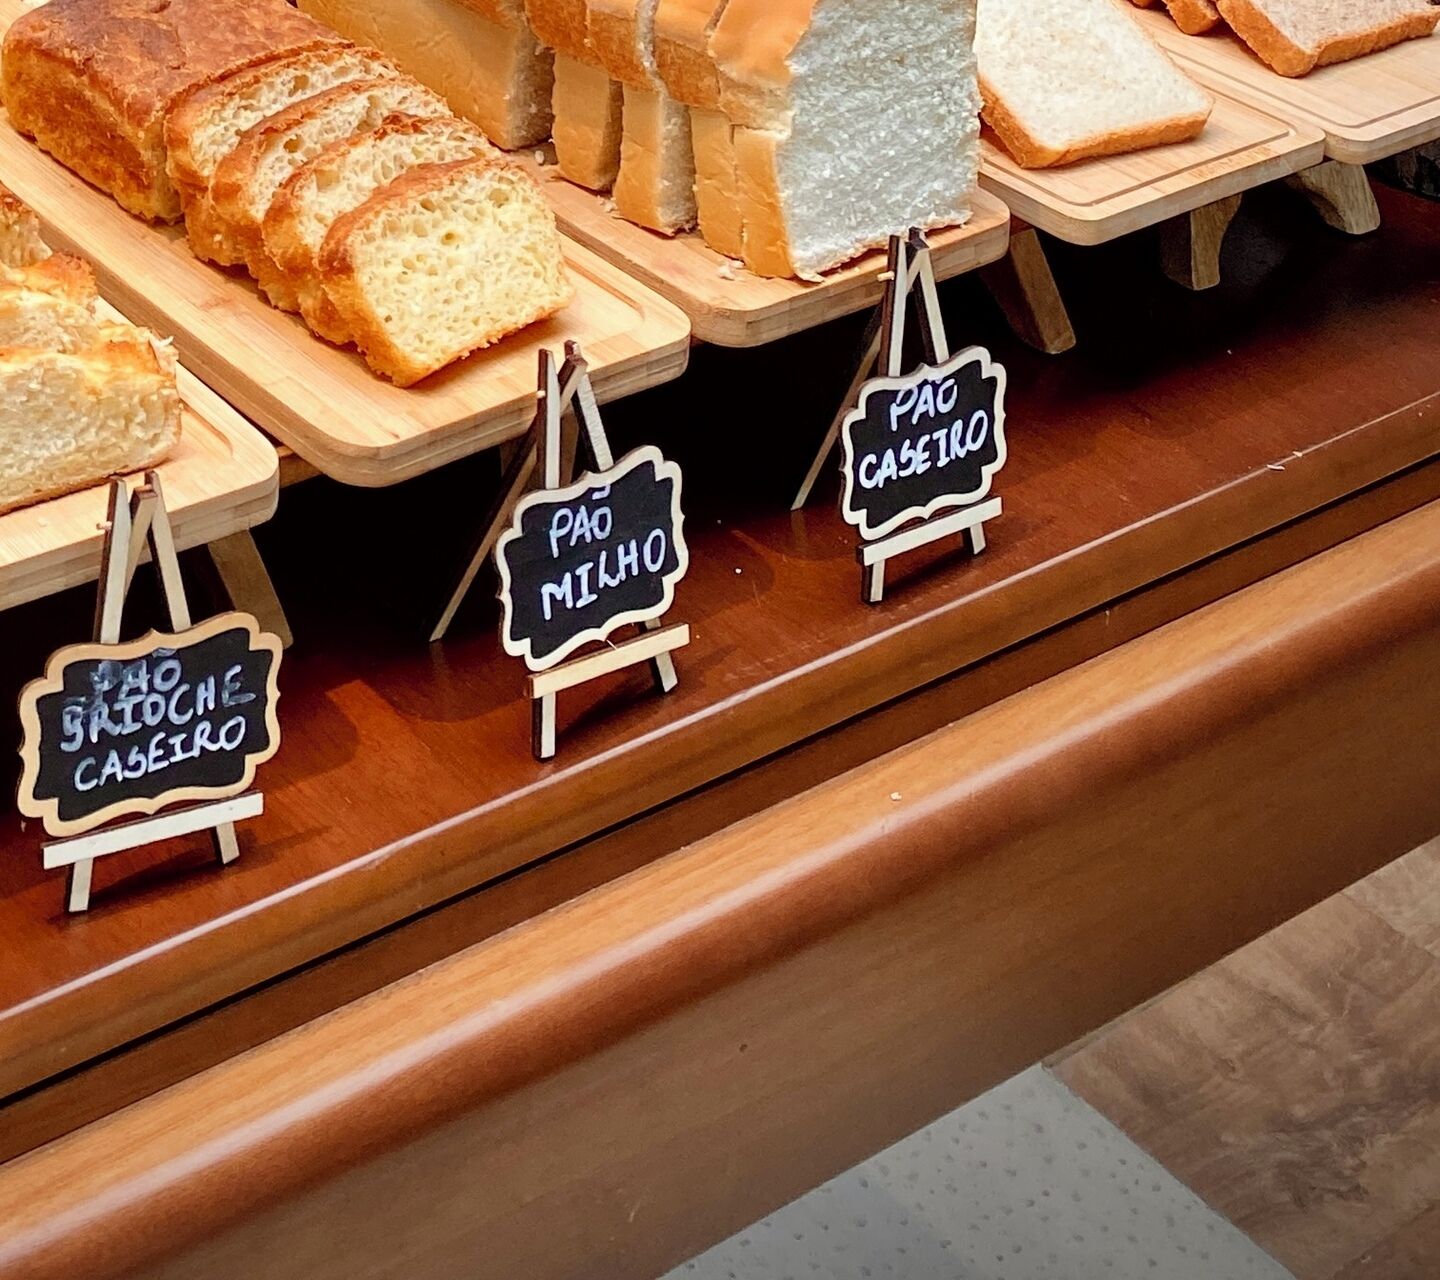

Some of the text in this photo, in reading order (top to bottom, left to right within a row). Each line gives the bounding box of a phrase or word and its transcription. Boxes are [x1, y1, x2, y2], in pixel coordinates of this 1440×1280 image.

[859, 409, 989, 489] CASEIRO
[549, 484, 612, 558] PÃO
[541, 528, 667, 621] MILHO
[74, 716, 246, 791] CASEIRO
